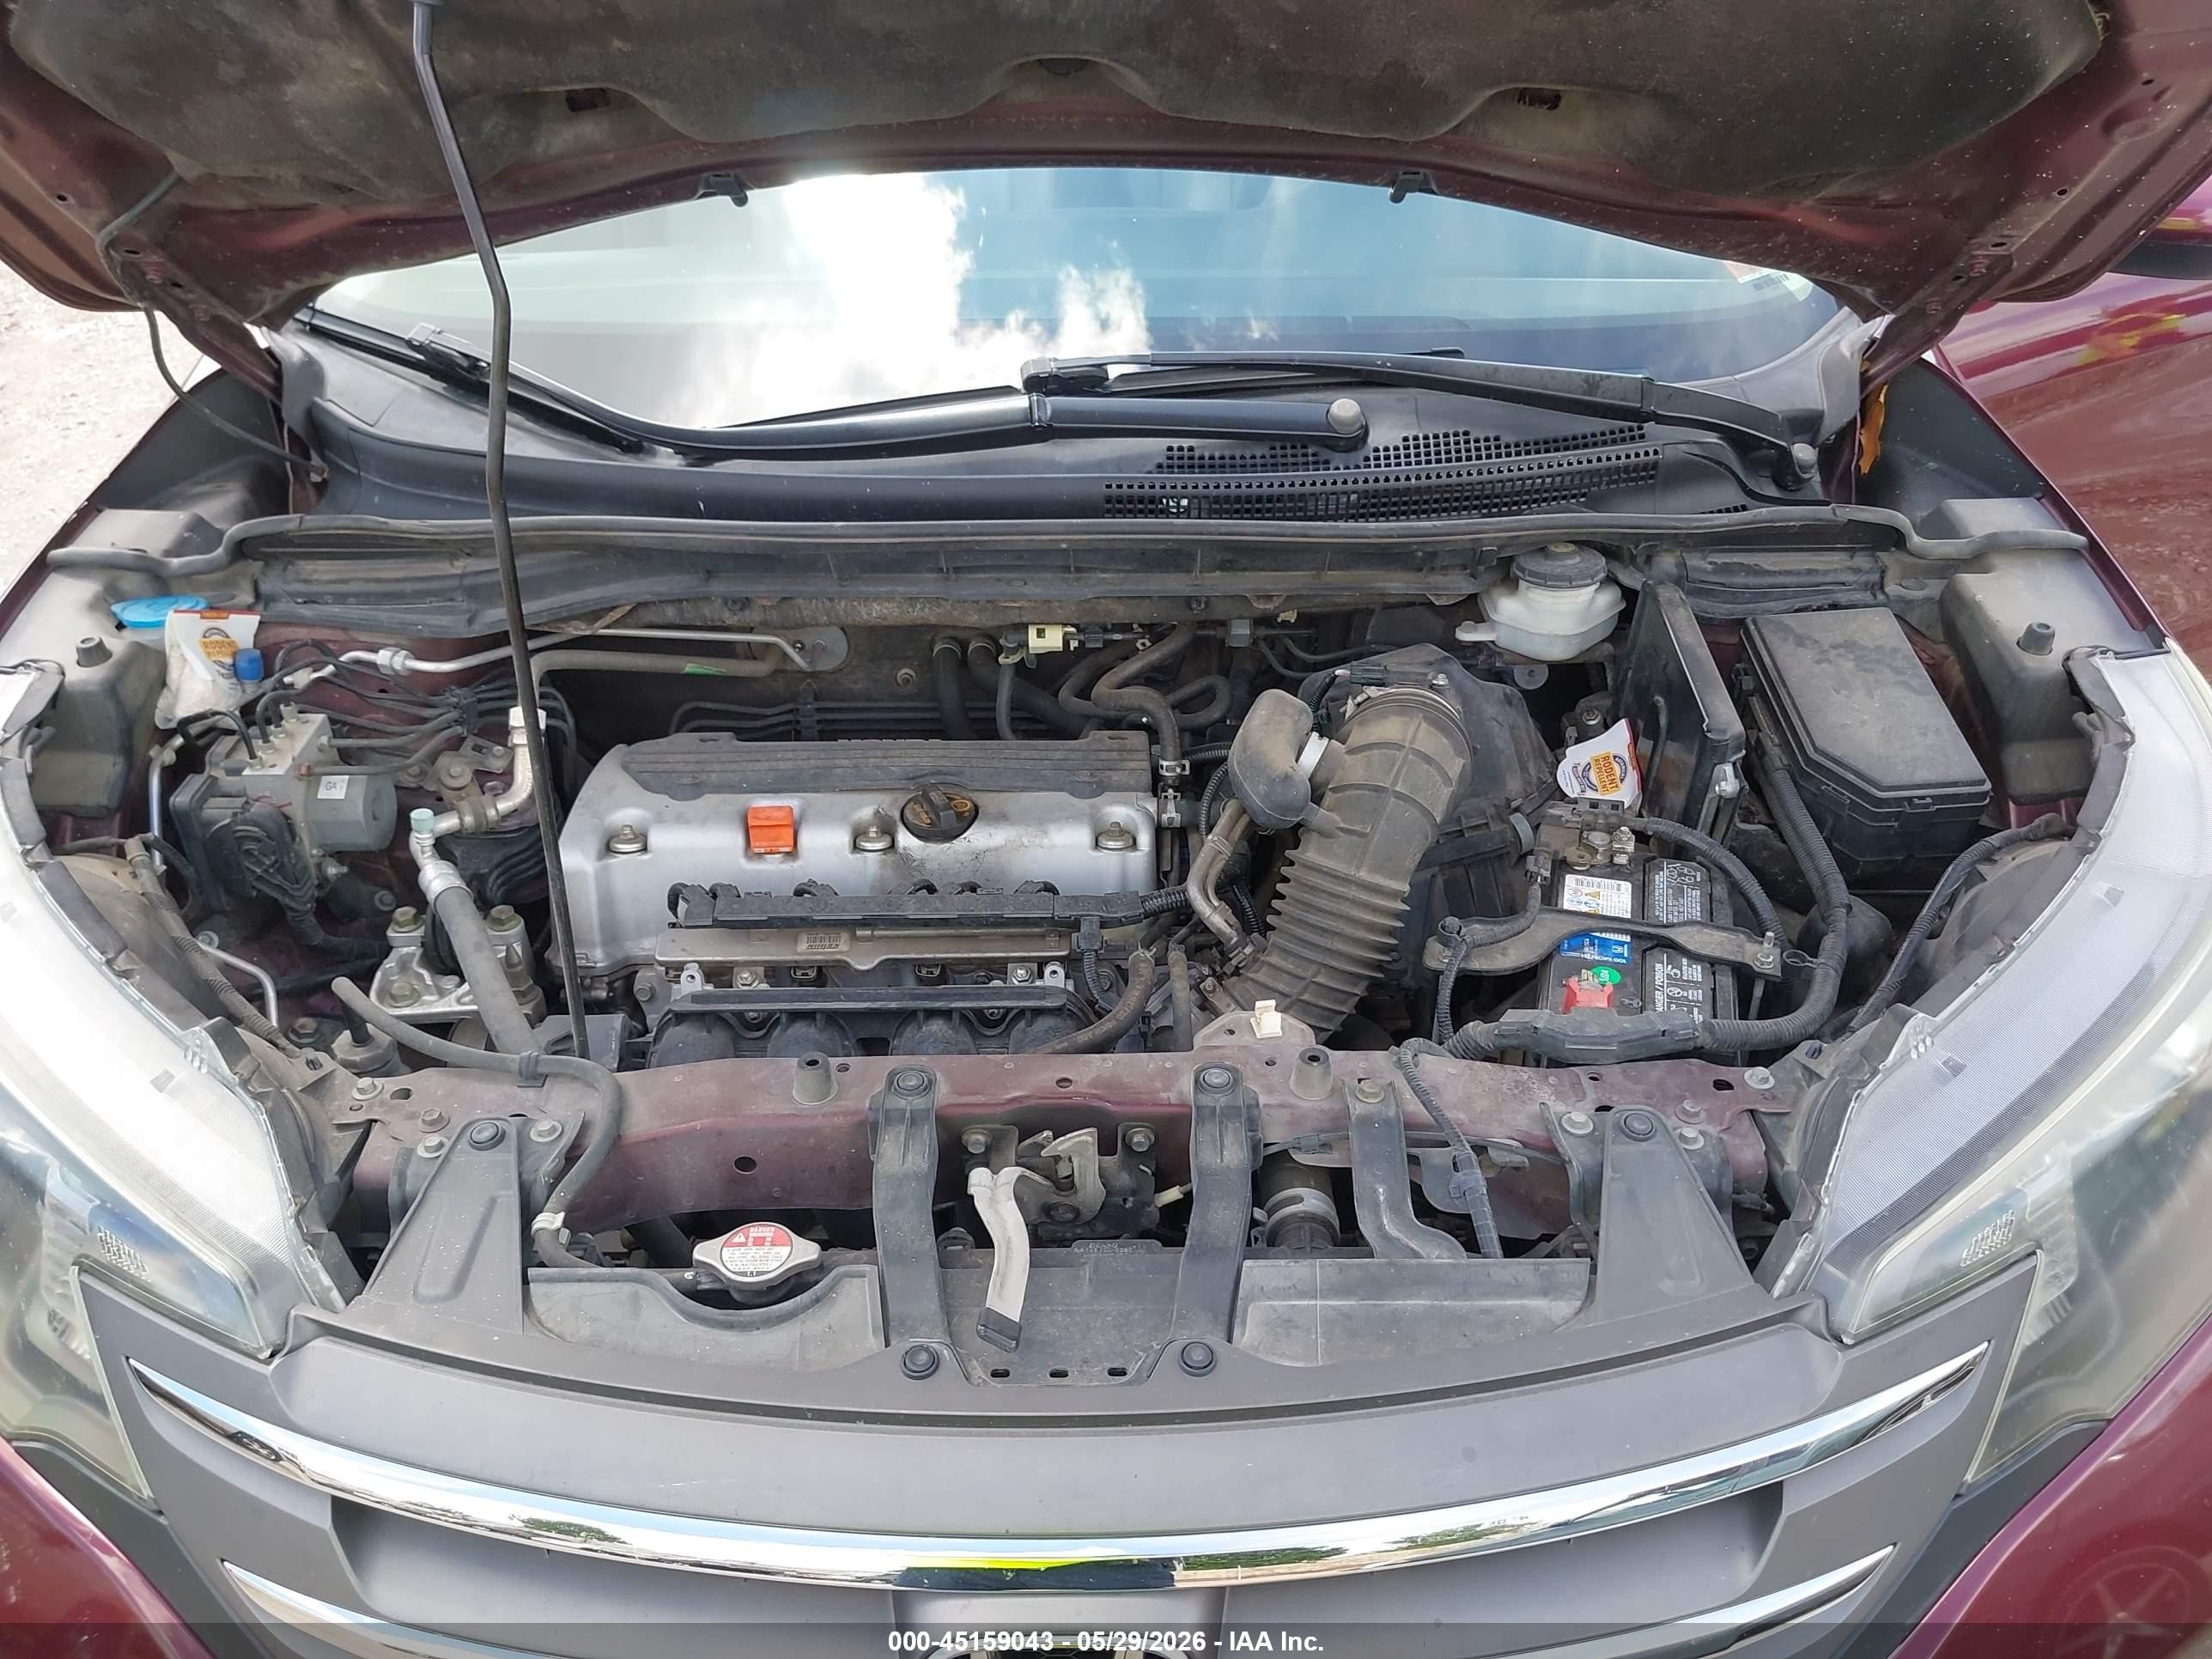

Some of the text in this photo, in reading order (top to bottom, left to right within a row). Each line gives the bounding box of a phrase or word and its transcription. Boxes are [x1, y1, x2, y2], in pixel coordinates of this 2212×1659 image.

[1593, 757, 1609, 793] REPELLENT
[1600, 754, 1619, 789] RODENT
[1655, 963, 1664, 986] POISON
